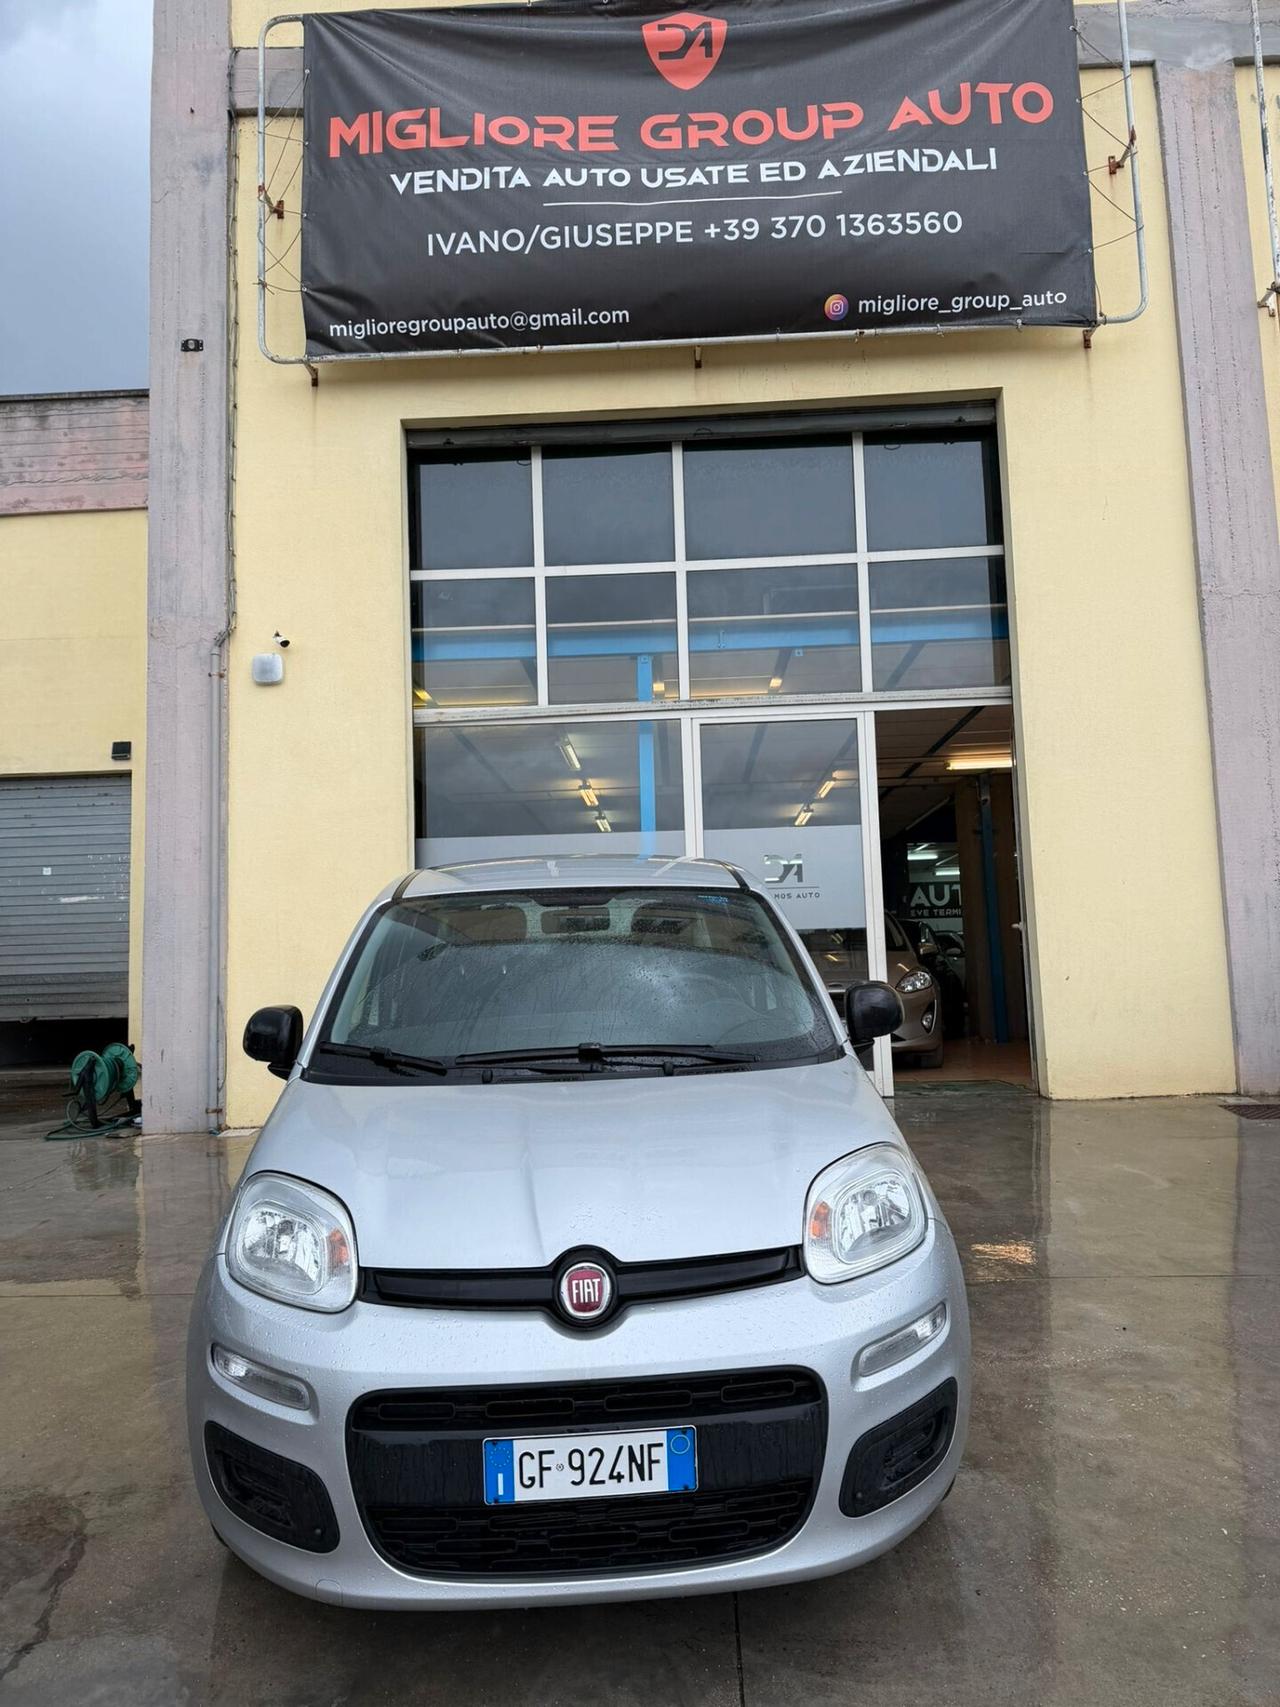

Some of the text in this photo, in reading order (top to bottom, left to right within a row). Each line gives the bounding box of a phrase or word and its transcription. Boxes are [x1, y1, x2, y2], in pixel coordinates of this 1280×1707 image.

[328, 81, 1054, 158] MIGLIORE GROUP AUTO
[390, 147, 998, 195] VENDITA AUTO USATE ED AZIENDALI
[427, 211, 963, 257] IVANO/GIUSEPPE +39 370 1363560
[858, 290, 1068, 315] migliore_group_auto
[328, 308, 631, 341] miglioregroupauto@gmail.com
[572, 1278, 600, 1304] FIAT
